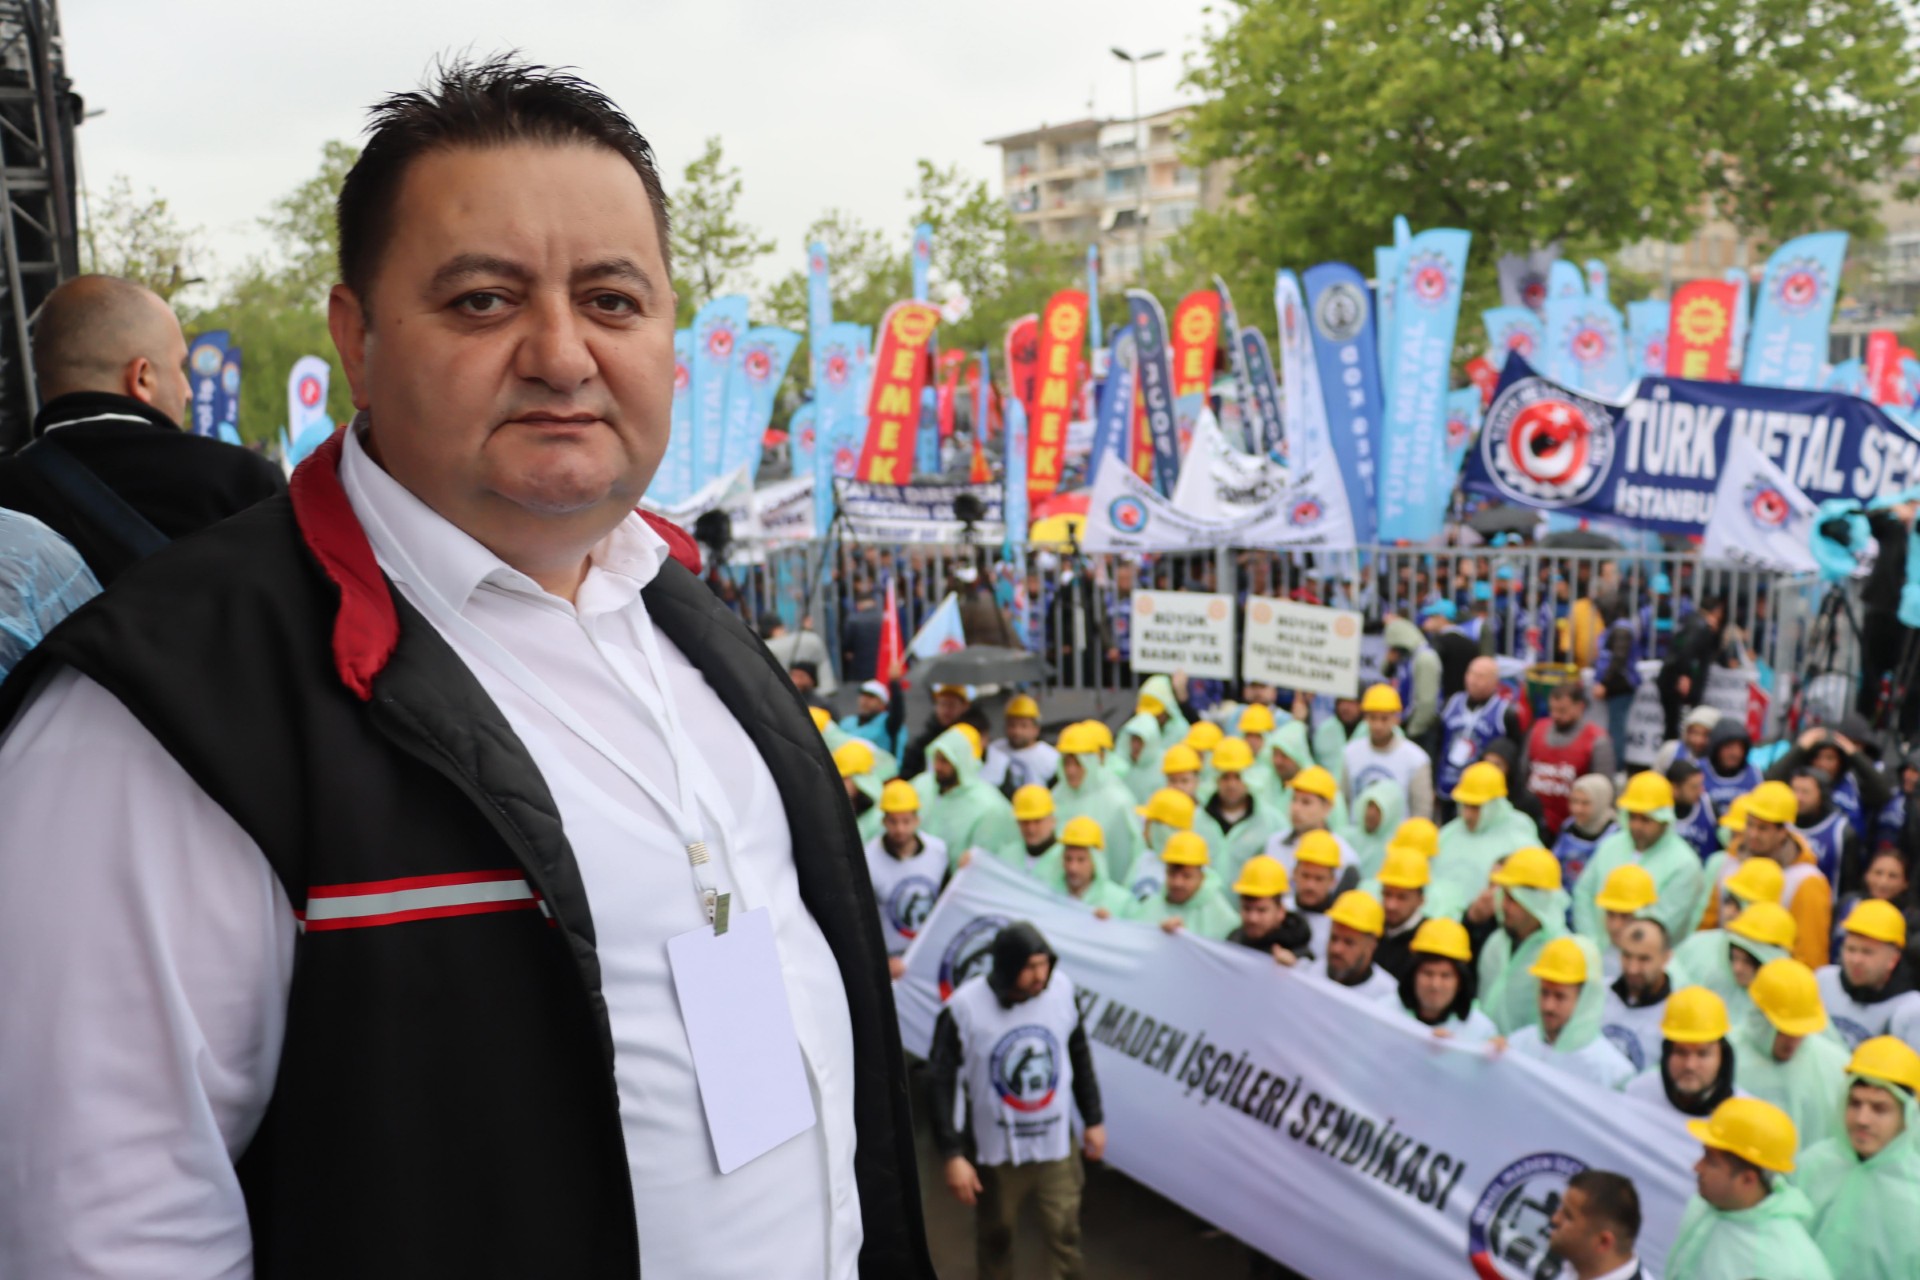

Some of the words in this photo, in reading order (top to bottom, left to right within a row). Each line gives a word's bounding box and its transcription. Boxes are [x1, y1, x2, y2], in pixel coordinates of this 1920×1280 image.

[868, 347, 916, 485] EMEK
[1031, 341, 1070, 477] EMEK
[1624, 383, 1725, 480] TÜRK
[1190, 650, 1223, 665] VAR
[1091, 999, 1189, 1077] MADEN
[1176, 1029, 1302, 1132] İŞÇİLERİ
[1288, 1091, 1467, 1213] SENDİKASI
